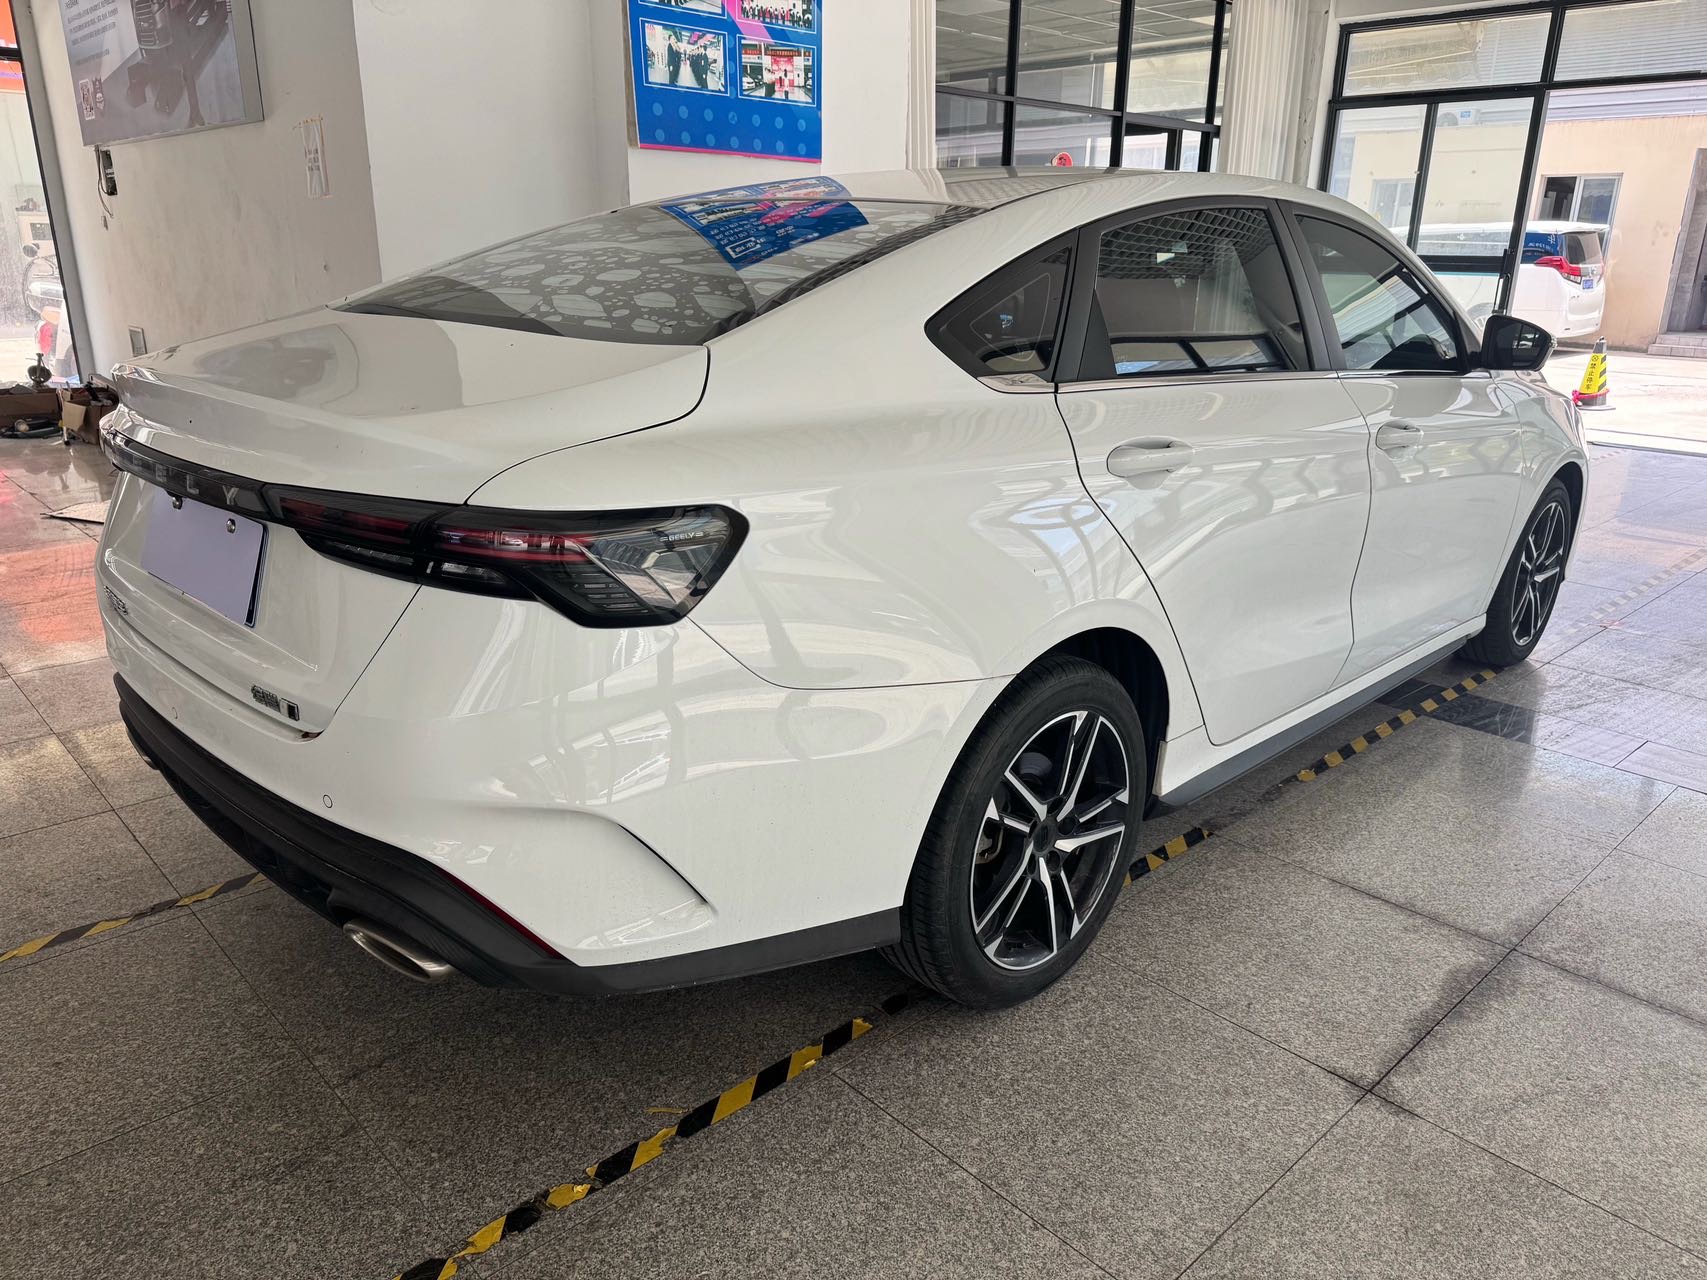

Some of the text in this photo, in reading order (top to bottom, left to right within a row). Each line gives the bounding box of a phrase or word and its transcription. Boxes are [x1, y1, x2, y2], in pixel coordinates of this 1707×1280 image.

[1586, 363, 1597, 390] 禁止停车
[669, 532, 695, 541] GEELY
